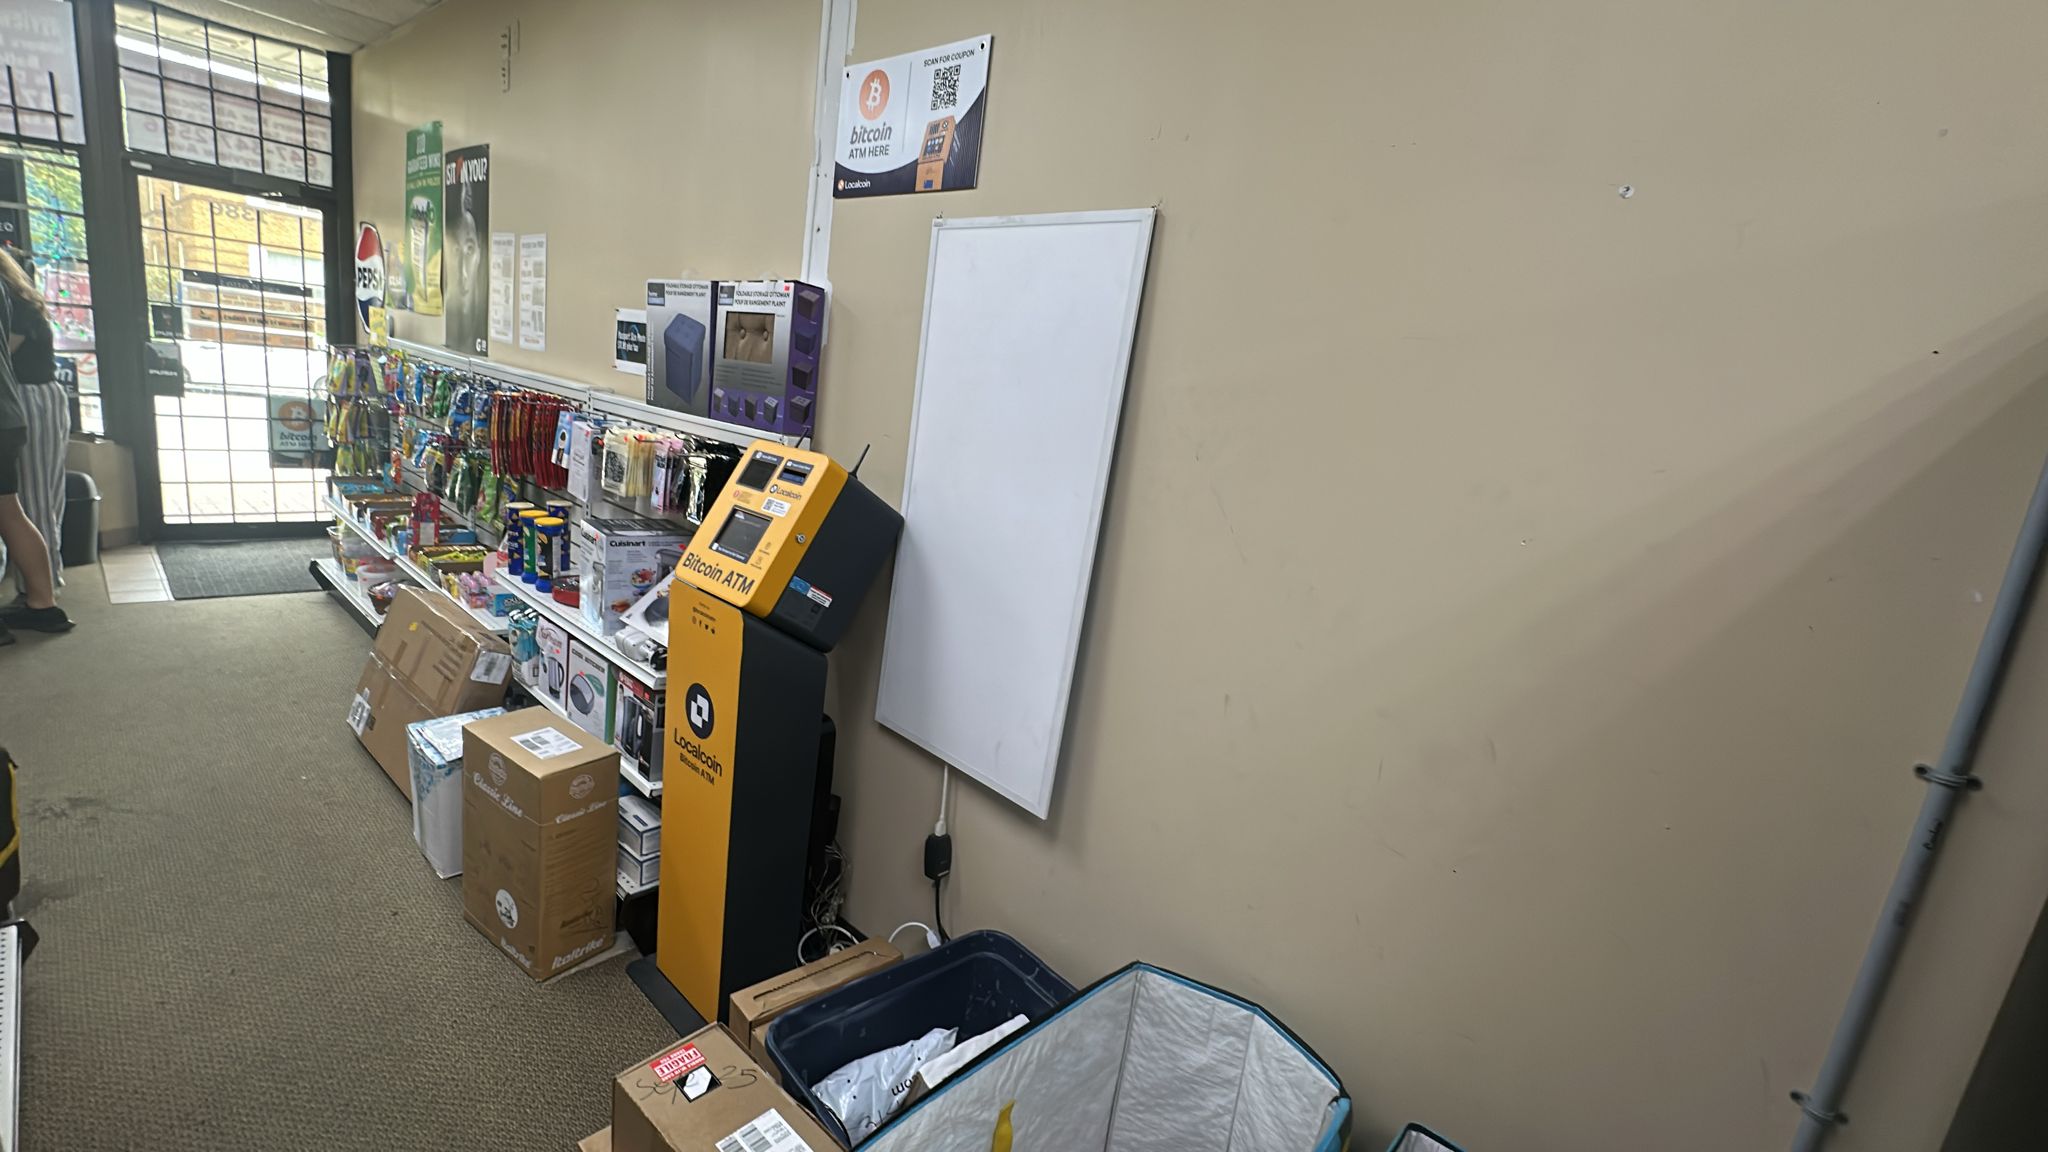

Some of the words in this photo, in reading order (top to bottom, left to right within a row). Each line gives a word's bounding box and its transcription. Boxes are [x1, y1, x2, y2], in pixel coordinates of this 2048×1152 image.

[923, 56, 940, 67] SCAN
[939, 53, 951, 63] FOR
[950, 49, 975, 61] COUPON
[850, 122, 893, 145] bitcoin
[848, 147, 867, 160] ATM
[868, 144, 890, 157] HERE
[467, 157, 488, 183] YOU?
[844, 178, 871, 189] Localcoin
[357, 266, 384, 291] PEPSI
[609, 539, 646, 547] Cuisinart
[682, 552, 724, 583] Bitcoin
[721, 572, 756, 596] ATM
[673, 727, 723, 777] Localcoin
[679, 752, 700, 777] Bitcoin
[700, 768, 715, 786] ATM
[473, 770, 501, 802] Classic
[654, 1049, 700, 1077] FRAGILE
